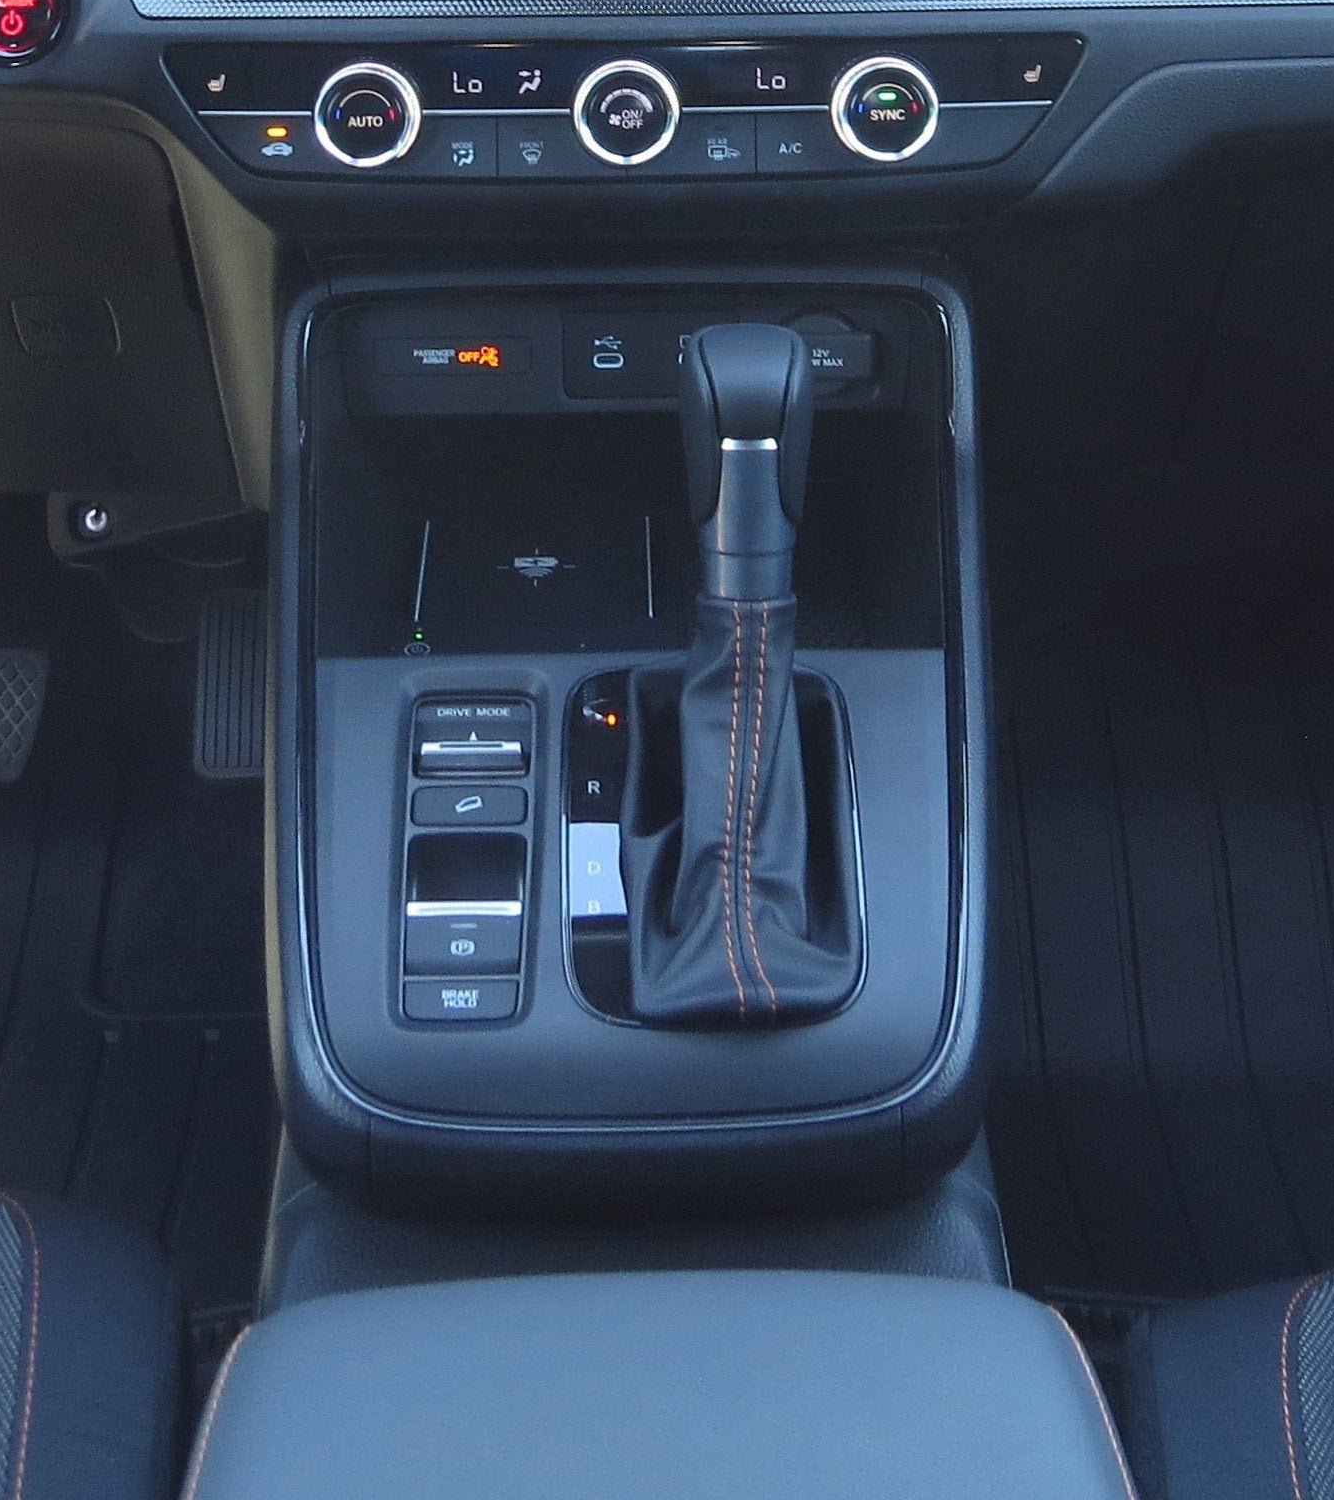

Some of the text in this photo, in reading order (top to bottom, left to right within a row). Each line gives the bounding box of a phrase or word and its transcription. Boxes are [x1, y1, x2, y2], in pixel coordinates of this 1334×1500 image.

[870, 109, 906, 121] SYNC
[348, 116, 384, 128] AUTO
[622, 119, 644, 130] OFF
[778, 142, 803, 155] A/C
[458, 351, 480, 362] OFF
[436, 707, 511, 718] DRIVE MODE
[587, 780, 601, 795] R
[587, 861, 601, 875] D
[441, 989, 479, 1000] BRAKE
[443, 999, 478, 1009] HOLD
